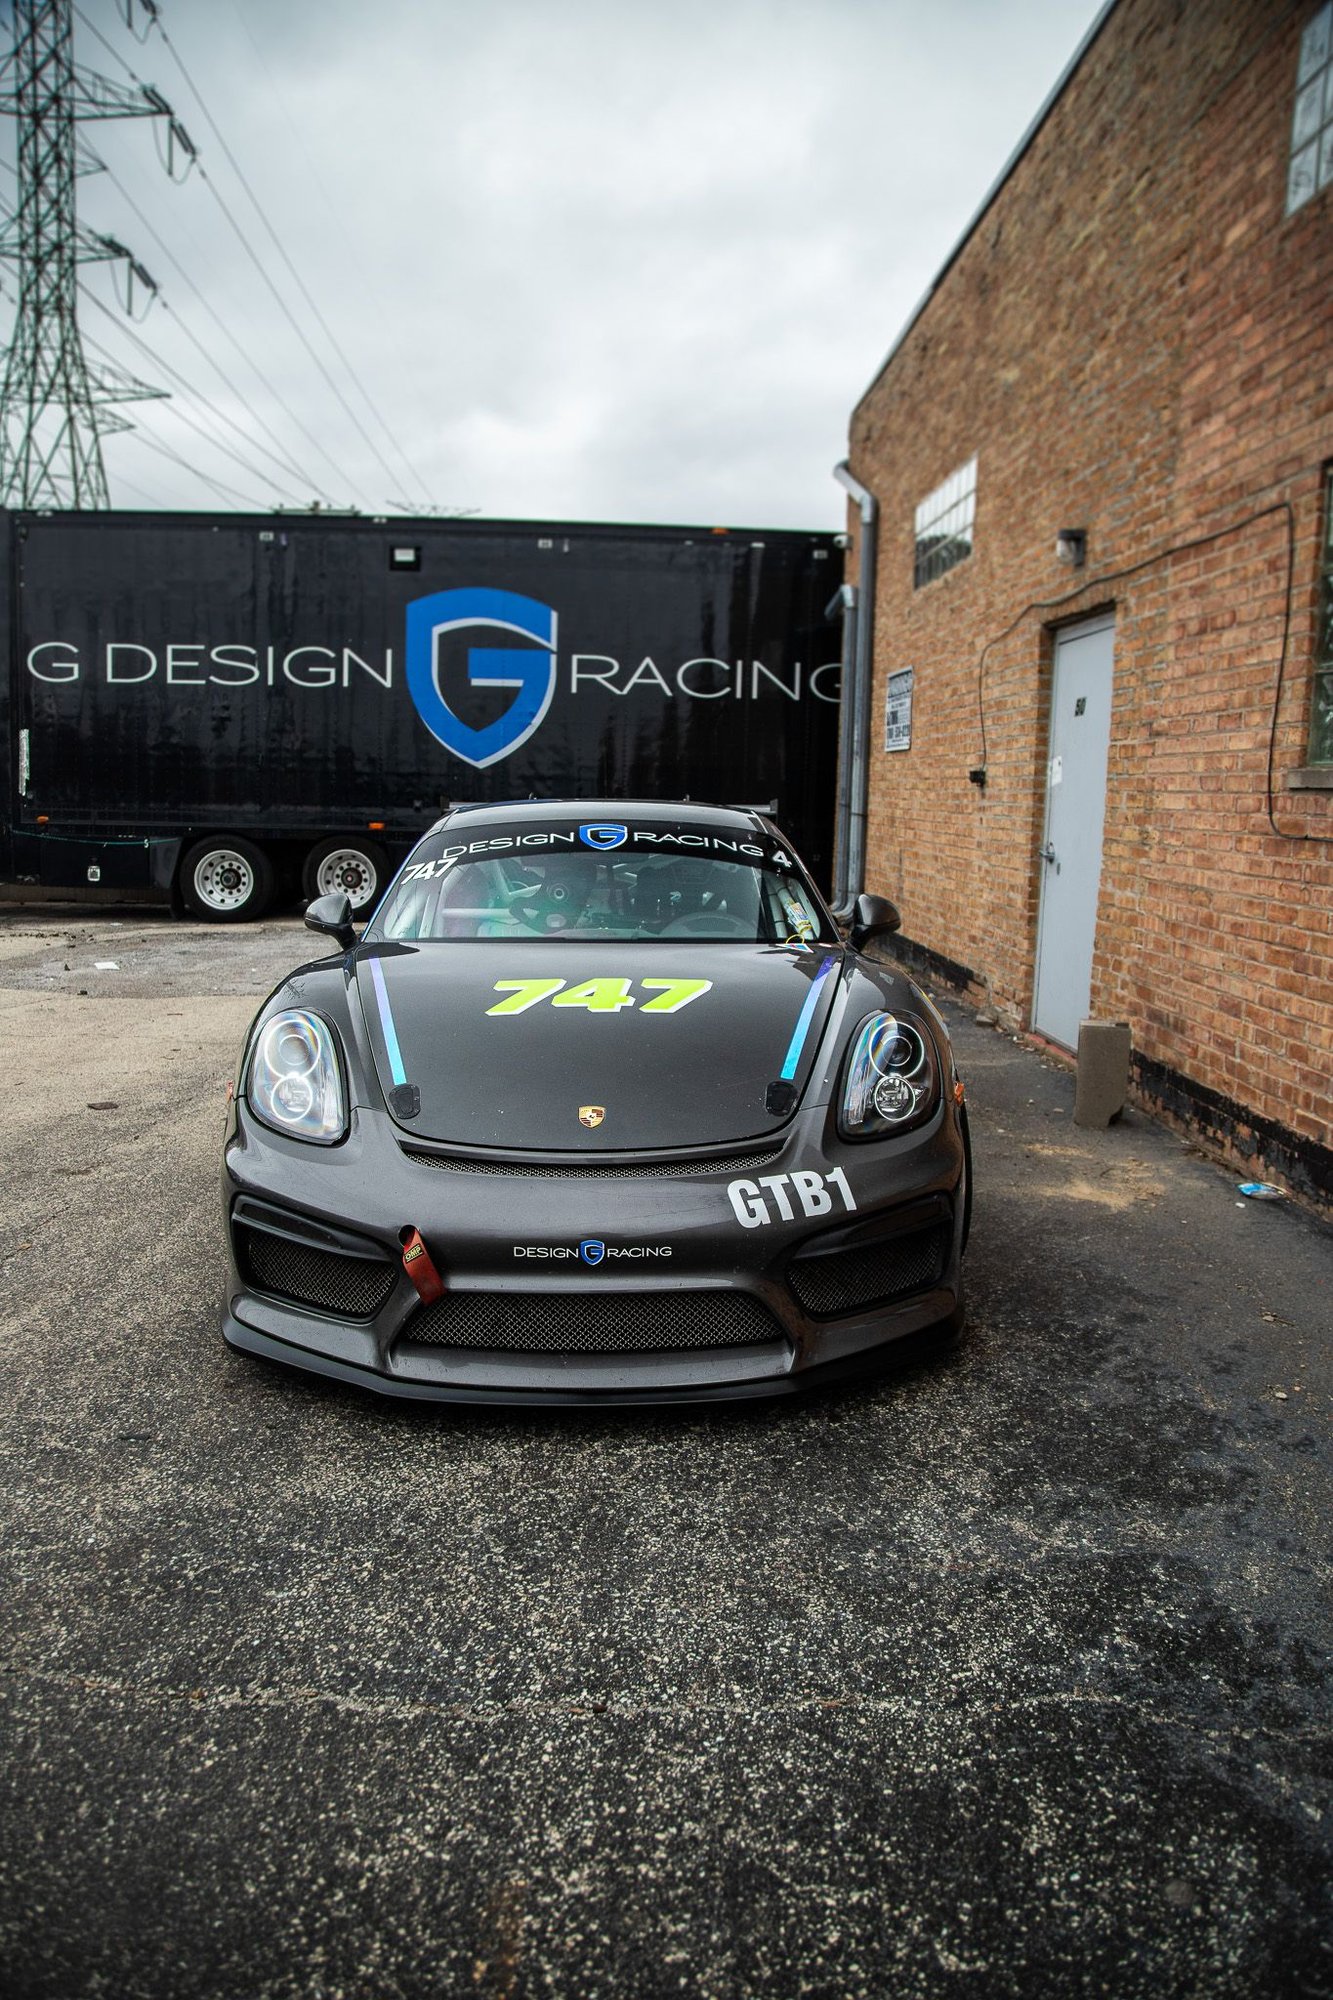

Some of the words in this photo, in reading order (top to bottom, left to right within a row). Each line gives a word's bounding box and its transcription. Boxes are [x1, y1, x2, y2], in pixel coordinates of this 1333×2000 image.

[27, 641, 79, 683] G
[106, 643, 393, 688] DESIGN
[571, 654, 844, 702] RACING
[443, 832, 574, 858] DESIGN
[633, 832, 764, 857] RACING
[400, 857, 459, 885] 747
[484, 977, 713, 1016] 747
[727, 1166, 858, 1229] GTB1
[405, 1245, 422, 1261] OMP
[513, 1246, 579, 1259] DESIGN
[607, 1246, 673, 1258] RACING
